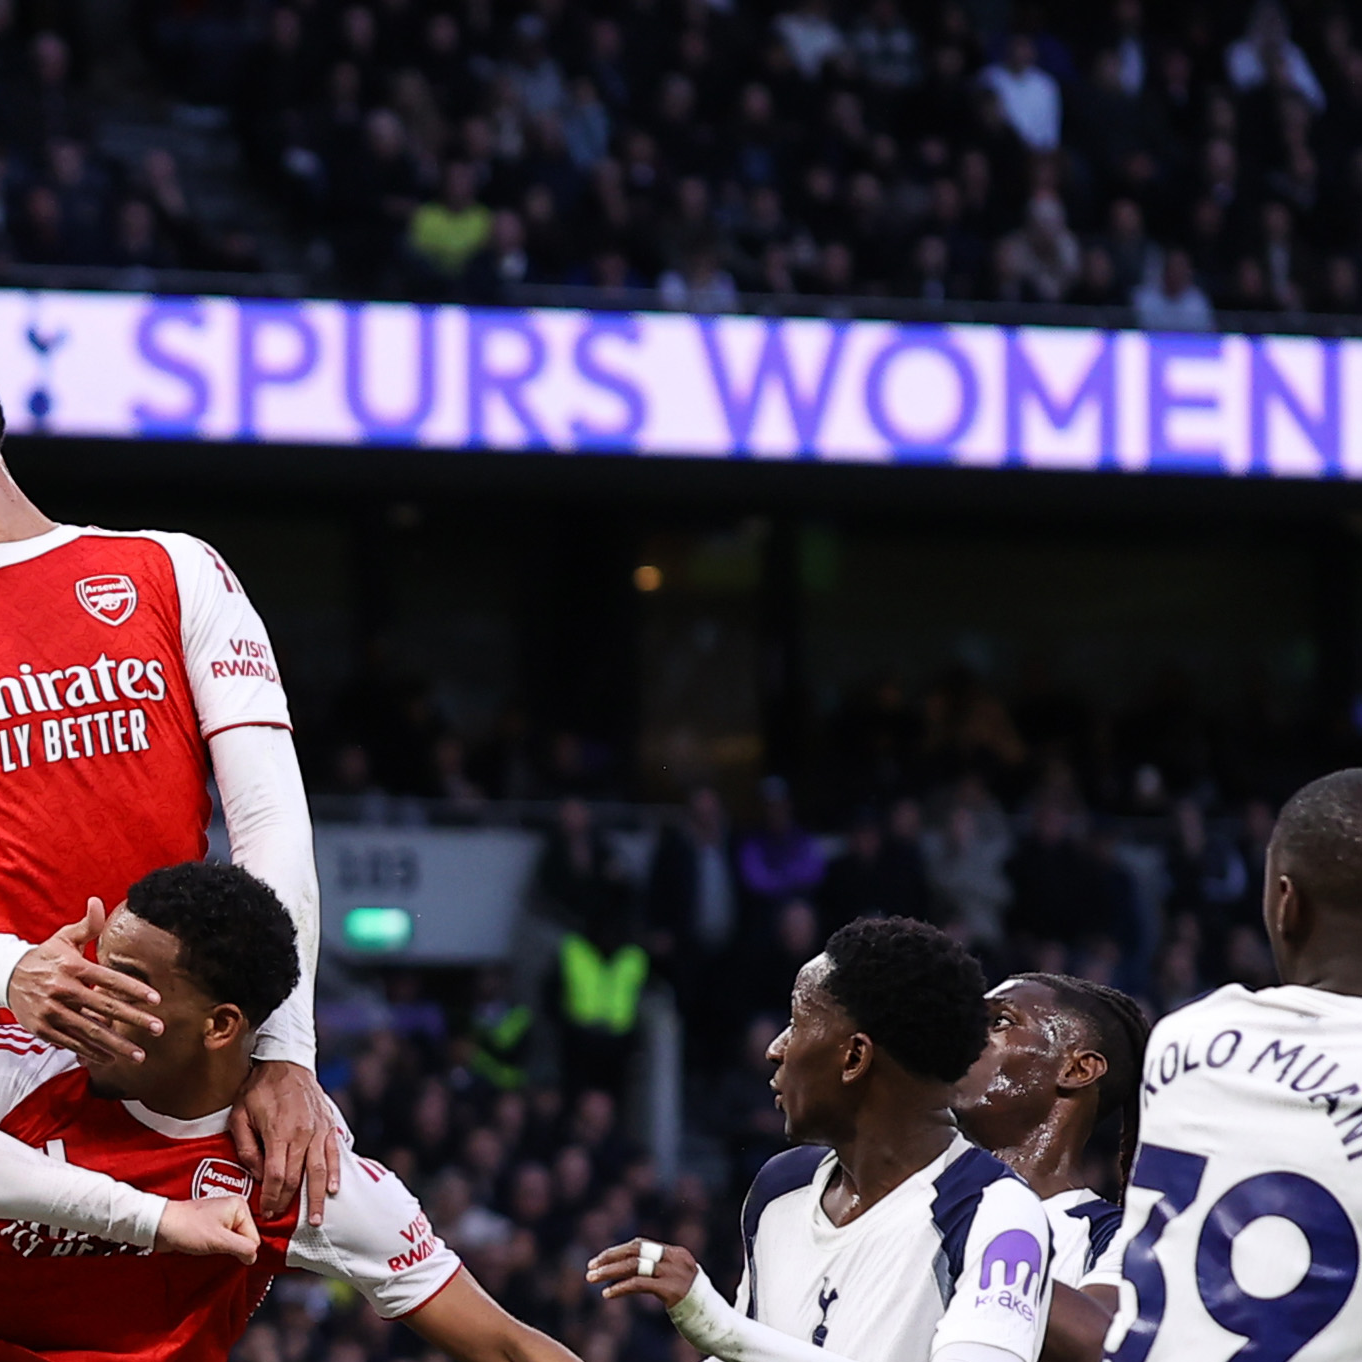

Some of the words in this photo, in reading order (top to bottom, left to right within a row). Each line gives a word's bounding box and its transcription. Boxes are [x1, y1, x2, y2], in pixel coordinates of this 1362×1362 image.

[131, 294, 647, 453] SPURS
[699, 312, 1341, 478] WOMEN
[210, 659, 282, 686] RWAND
[41, 708, 150, 763] BETTER
[203, 1166, 248, 1190] Arsenal
[399, 1213, 427, 1244] VIS
[974, 1290, 1035, 1321] kake
